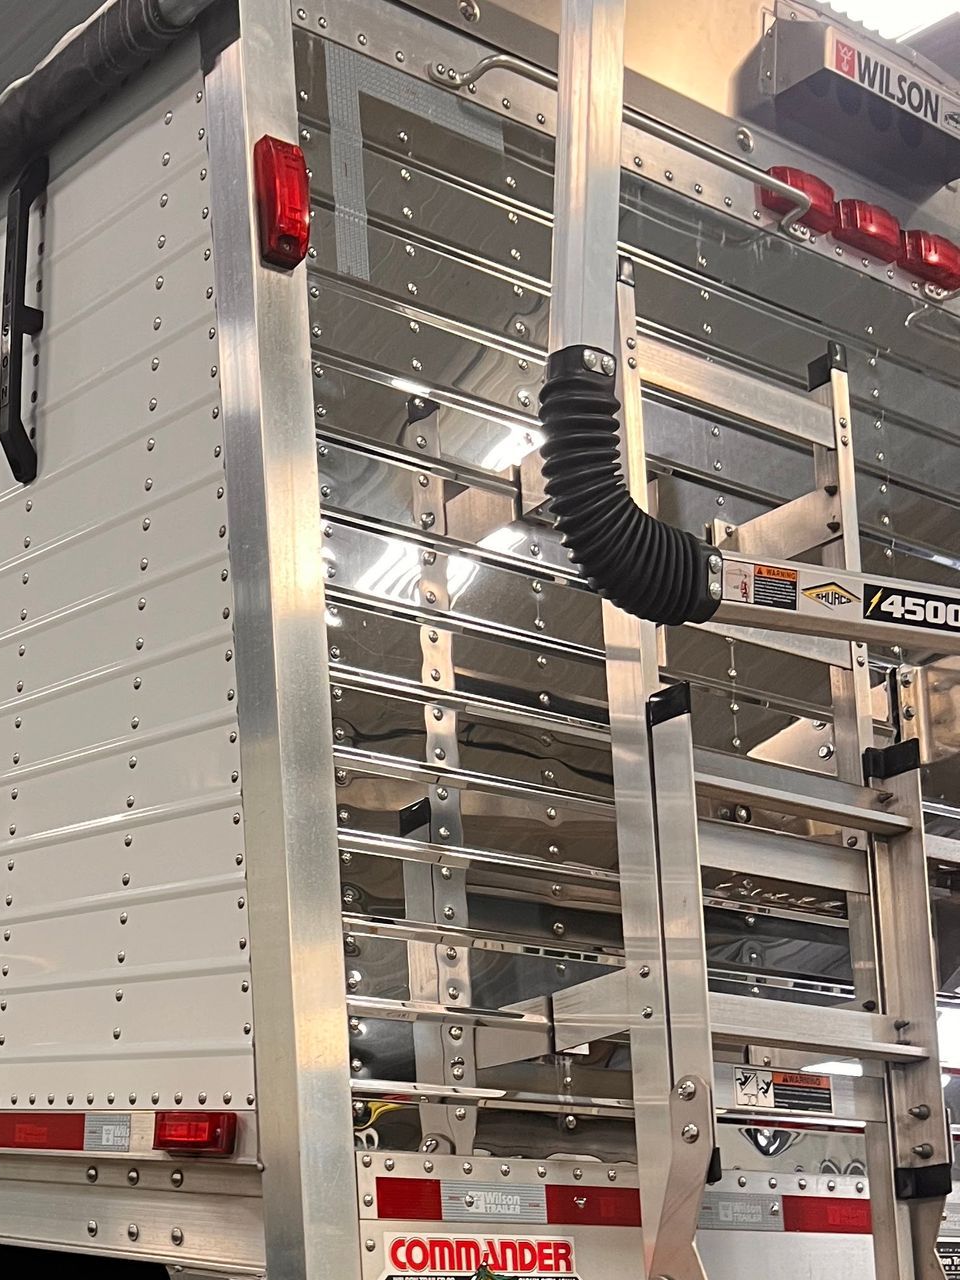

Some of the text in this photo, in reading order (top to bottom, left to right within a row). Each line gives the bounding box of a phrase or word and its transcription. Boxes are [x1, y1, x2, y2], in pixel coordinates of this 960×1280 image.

[857, 50, 940, 124] WILSON
[766, 568, 796, 580] WARNING
[484, 1191, 521, 1205] Wilson
[485, 1204, 521, 1215] TRAILER
[390, 1238, 573, 1272] COMMANDER
